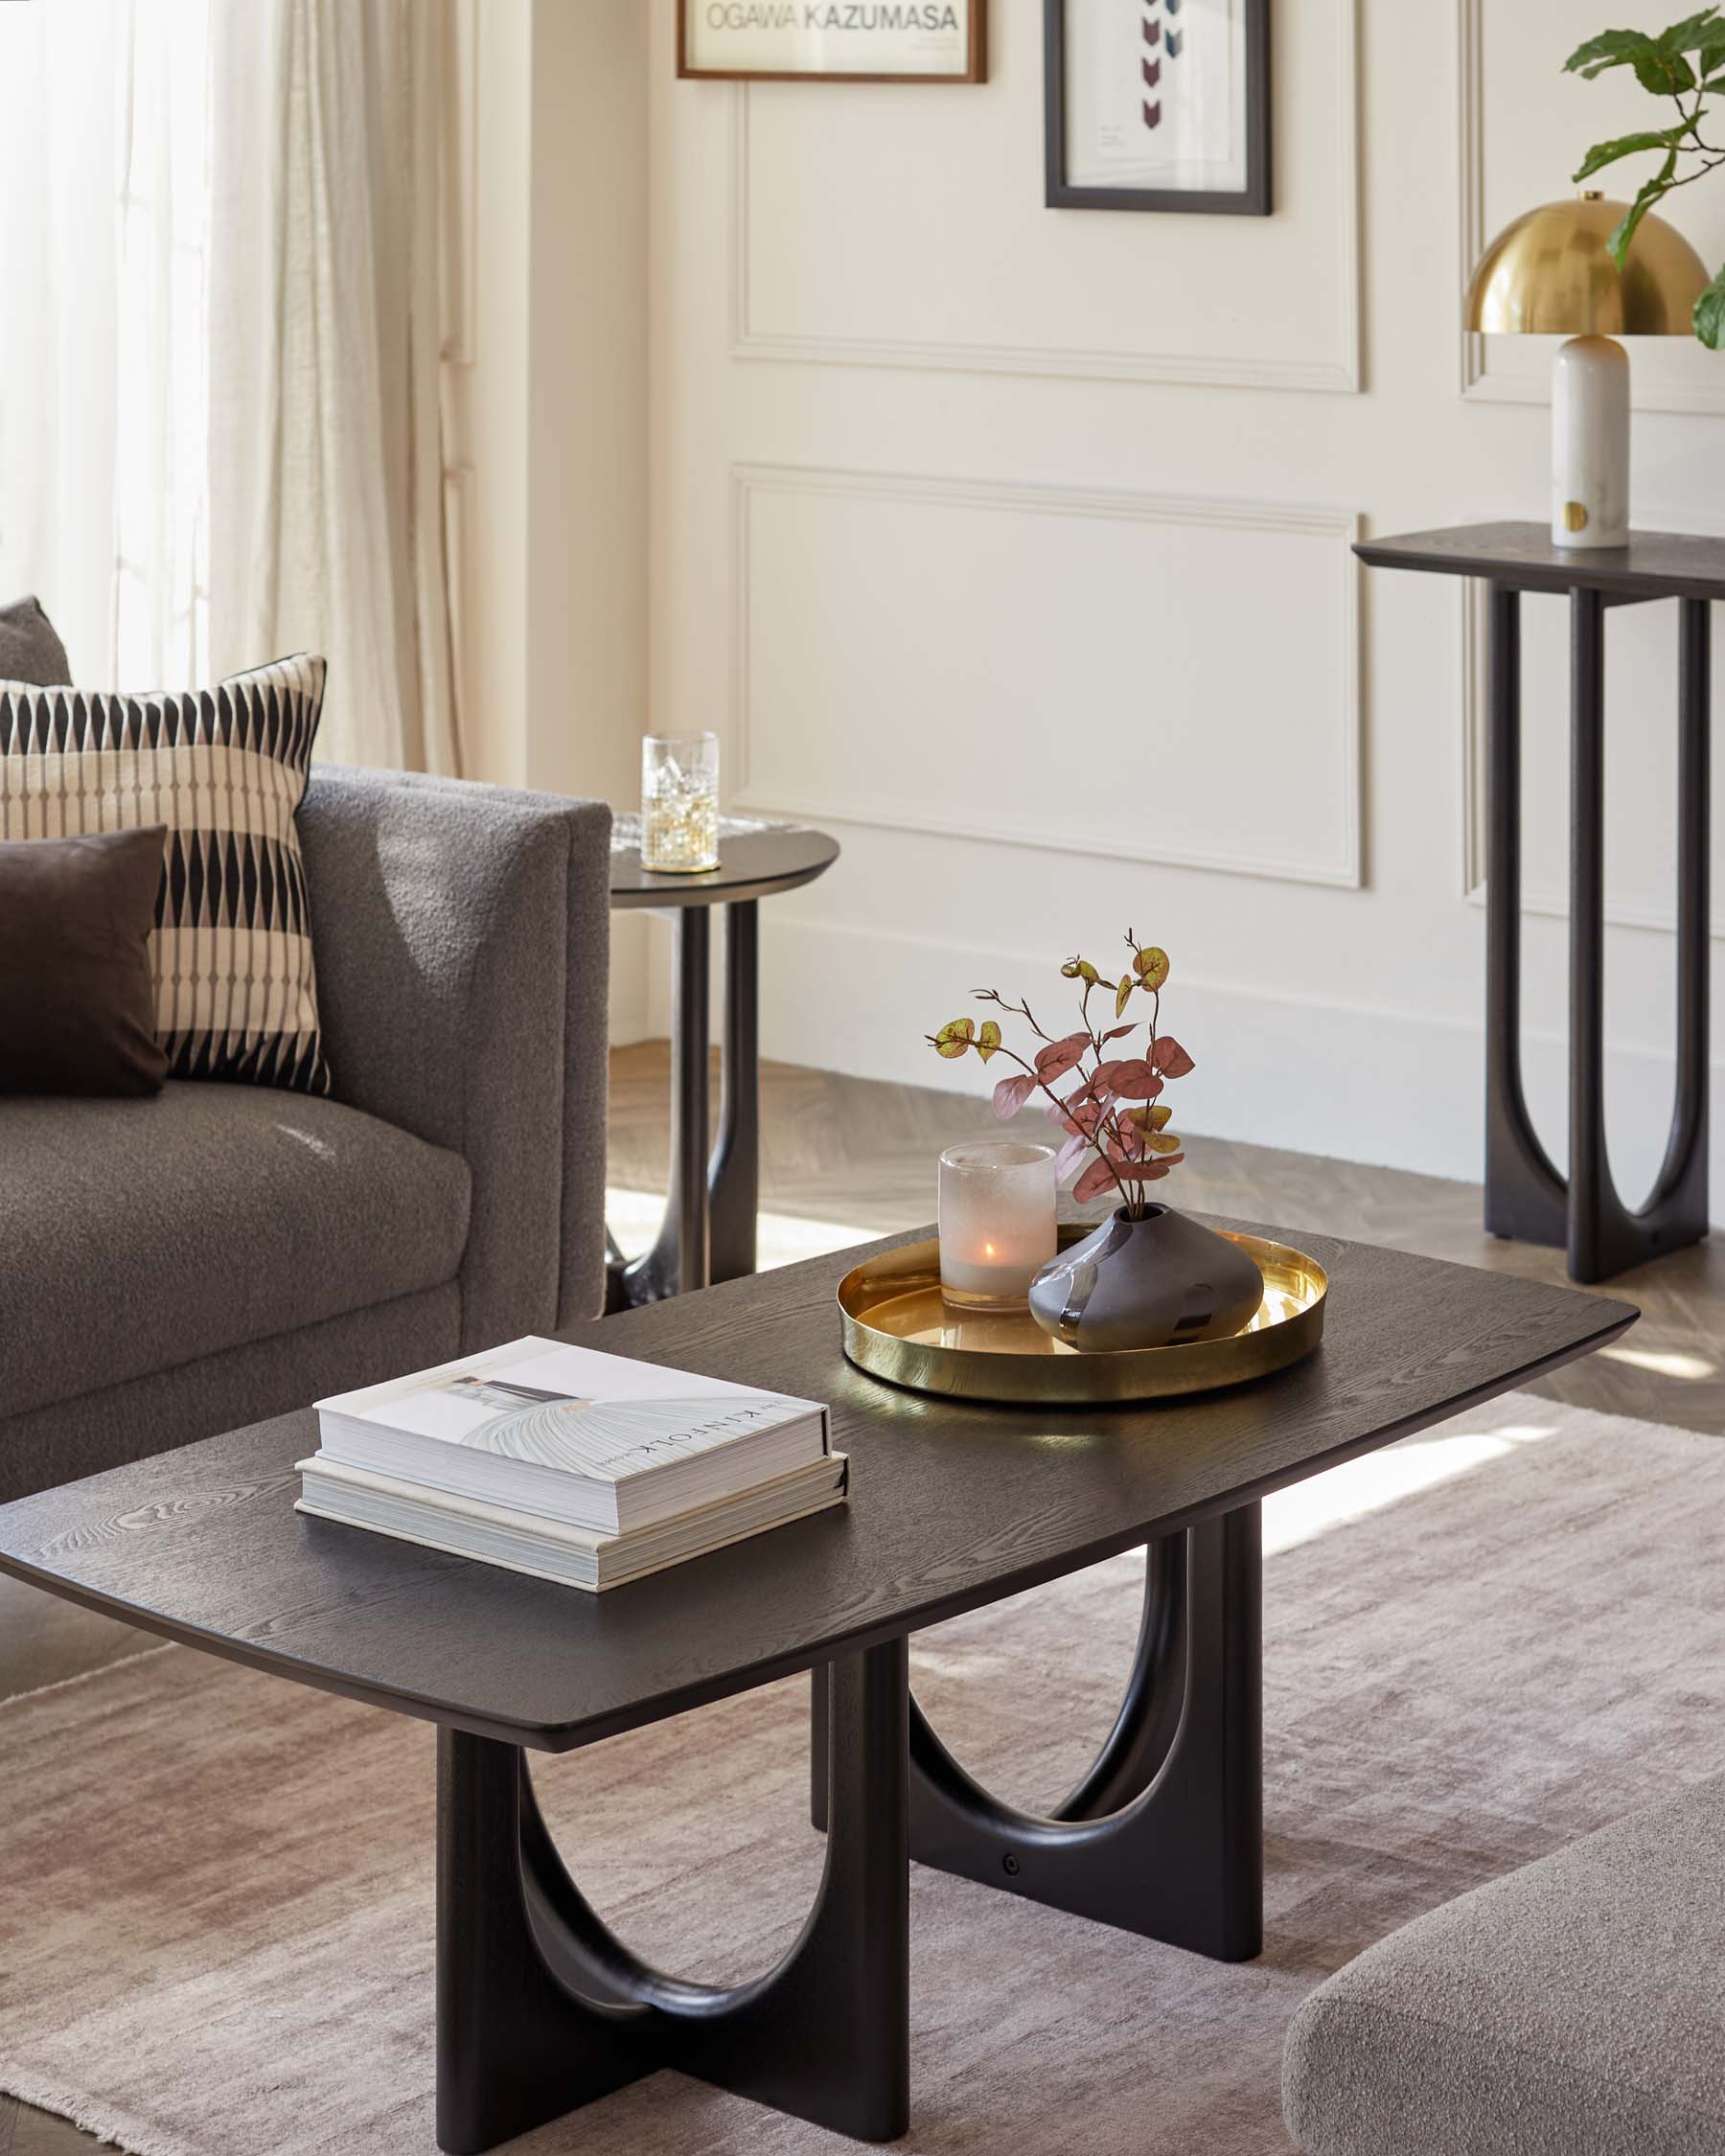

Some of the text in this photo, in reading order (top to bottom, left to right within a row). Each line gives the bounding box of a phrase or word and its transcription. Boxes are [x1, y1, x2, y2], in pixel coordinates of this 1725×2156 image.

[705, 3, 959, 31] OGAWA KAZUMASA
[630, 1410, 761, 1454] KINFOLK
